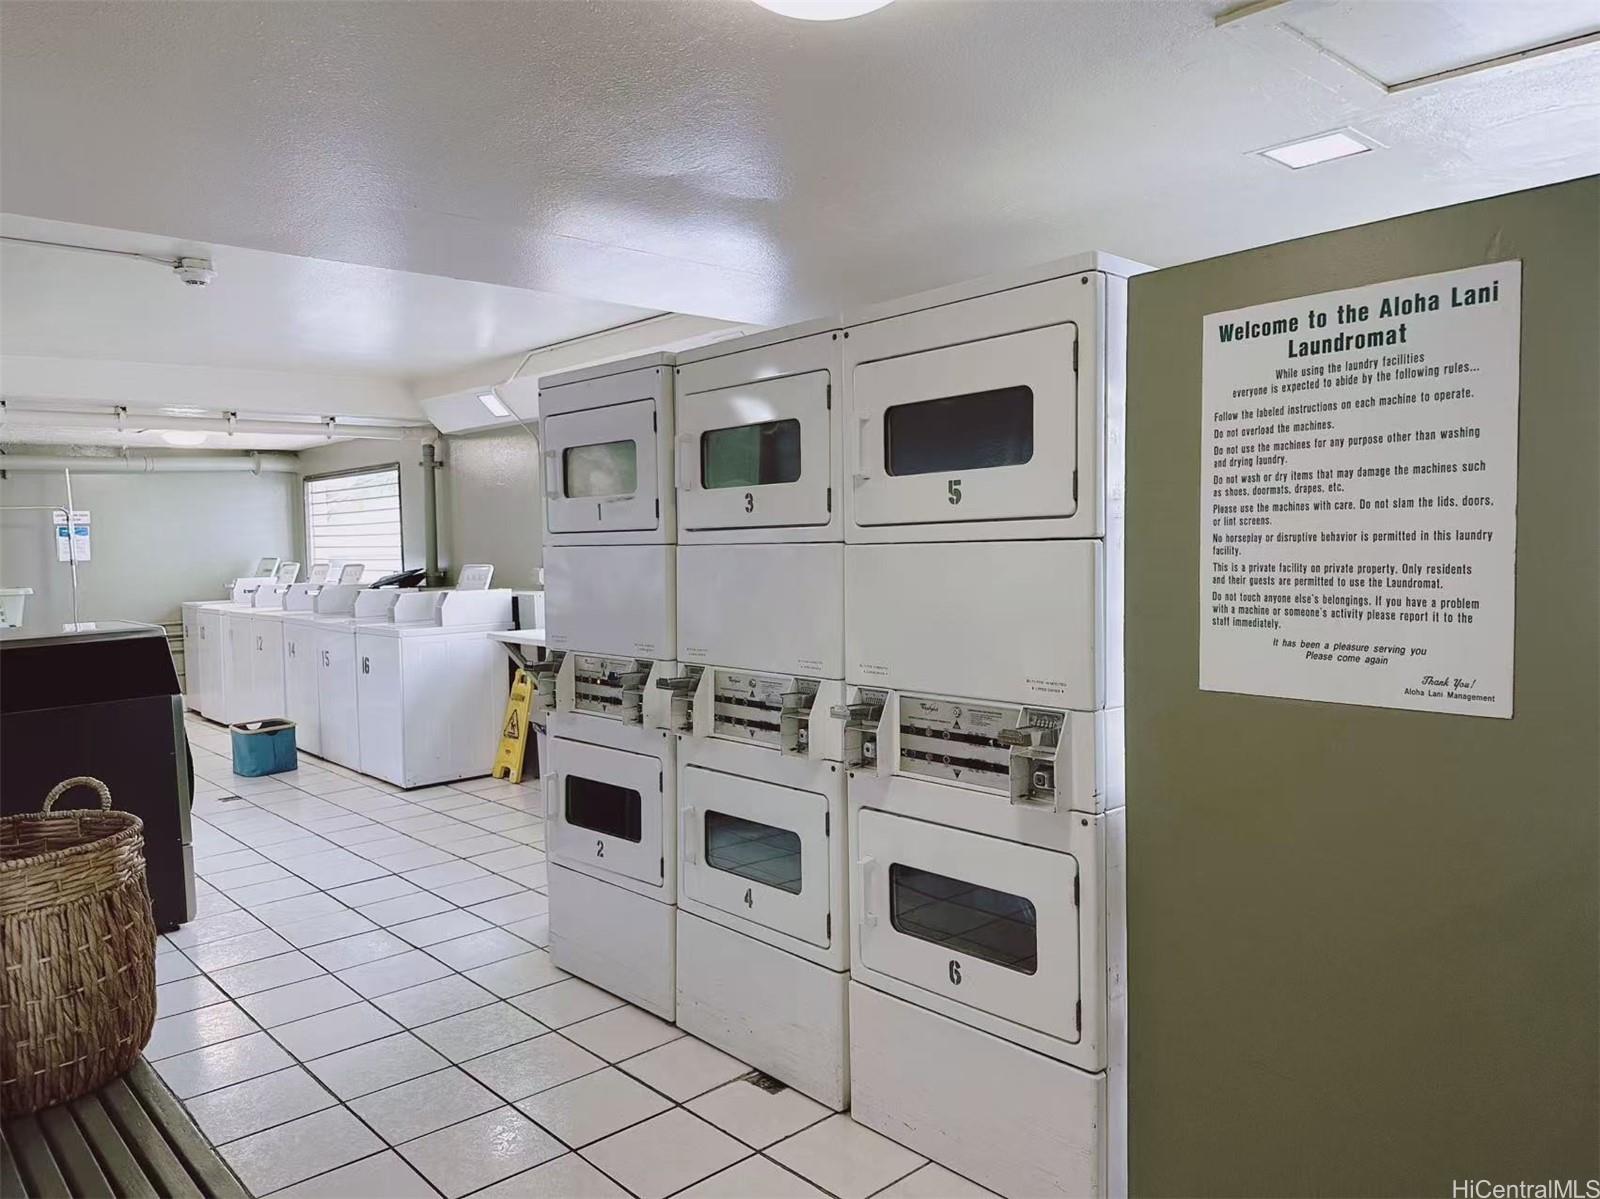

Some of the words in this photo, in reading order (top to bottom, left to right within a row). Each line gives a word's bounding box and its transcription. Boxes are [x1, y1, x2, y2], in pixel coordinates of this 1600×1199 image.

[1219, 314, 1298, 343] Welcome
[1308, 307, 1326, 329] to
[1336, 300, 1368, 325] the
[1379, 289, 1439, 319] Aloha
[1451, 279, 1498, 308] Lani
[1288, 322, 1406, 359] Laundromat
[1275, 367, 1298, 380] While
[1301, 363, 1325, 378] using
[1328, 361, 1342, 373] the
[1345, 356, 1379, 373] laundry
[1382, 350, 1425, 367] facilities
[1232, 386, 1268, 399] everyone
[1271, 383, 1279, 393] is
[1281, 378, 1320, 394] expected
[1323, 377, 1332, 388] to
[1335, 373, 1359, 386] abide
[1362, 371, 1373, 385] by
[1376, 369, 1392, 382] the
[1395, 363, 1439, 381] following
[1443, 359, 1480, 374] rules...
[1214, 410, 1239, 422] Follow
[1241, 408, 1254, 419] the
[1256, 405, 1285, 418] labeled
[1287, 400, 1338, 415] instructions
[1341, 400, 1352, 409] on
[1355, 396, 1376, 408] each
[1379, 391, 1417, 406] machine
[1420, 391, 1430, 402] to
[1434, 386, 1474, 401] operate.
[1213, 428, 1224, 438] Do
[1226, 427, 1239, 437] not
[1241, 424, 1275, 436] overload
[1277, 422, 1290, 433] the
[1293, 418, 1335, 432] machines.
[1213, 445, 1224, 455] Do
[1226, 445, 1239, 454] not
[1241, 444, 1255, 453] use
[1258, 441, 1271, 452] the
[1273, 438, 1311, 451] machines
[1314, 437, 1327, 448] for
[1329, 438, 1345, 448] any
[1348, 434, 1384, 447] purpose
[1387, 430, 1412, 443] other
[1415, 428, 1436, 441] than
[1440, 425, 1480, 440] washing
[1214, 457, 1227, 468] and
[1229, 455, 1254, 468] drying
[1256, 453, 1288, 467] laundry.
[1213, 474, 1223, 484] Do
[1225, 474, 1238, 484] not
[1241, 472, 1261, 483] wash
[1263, 474, 1273, 482] or
[1275, 471, 1288, 483] dry
[1291, 469, 1314, 480] items
[1317, 468, 1333, 479] that
[1336, 469, 1354, 479] may
[1357, 465, 1391, 478] damage
[1394, 464, 1409, 475] the
[1412, 461, 1458, 474] machines
[1462, 459, 1486, 472] such
[948, 479, 962, 505] 5
[1213, 489, 1222, 497] as
[1328, 481, 1345, 492] etc.
[744, 493, 754, 513] 3
[1212, 503, 1237, 514] Please
[1240, 504, 1254, 513] use
[1257, 502, 1270, 512] the
[1272, 500, 1310, 512] machines
[1313, 500, 1332, 510] with
[1334, 501, 1356, 510] care.
[1359, 498, 1371, 509] Do
[1374, 498, 1389, 509] not
[1392, 497, 1415, 508] slam
[1418, 496, 1434, 507] the
[1212, 518, 1221, 526] or
[1223, 516, 1236, 526] lint
[1239, 517, 1272, 526] screens.
[1212, 533, 1223, 542] No
[1225, 532, 1263, 544] horseplay
[1265, 534, 1274, 542] or
[1276, 531, 1318, 543] disruptive
[1320, 531, 1358, 542] behavior
[1360, 530, 1369, 541] is
[1372, 530, 1417, 542] permitted
[1420, 530, 1429, 540] in
[1433, 529, 1452, 541] this
[1455, 529, 1493, 542] laundry
[1212, 545, 1242, 555] facility.
[1212, 562, 1229, 571] This
[1231, 562, 1239, 572] is
[1241, 564, 1246, 572] a
[1248, 562, 1276, 574] private
[1279, 562, 1308, 574] facility
[1323, 563, 1354, 574] private
[1357, 563, 1399, 575] property.
[1402, 563, 1423, 575] Only
[1426, 563, 1472, 575] residents
[1212, 574, 1226, 584] and
[1228, 575, 1247, 584] their
[1249, 575, 1275, 586] guests
[1278, 577, 1291, 585] are
[1294, 575, 1334, 587] permitted
[1337, 577, 1346, 586] to
[1349, 578, 1365, 587] use
[1368, 576, 1383, 587] the
[1386, 576, 1444, 588] Laundromat.
[1212, 591, 1222, 600] Do
[1225, 592, 1237, 601] not
[1239, 592, 1261, 602] touch
[1263, 594, 1291, 604] anyone
[1294, 593, 1321, 604] else's
[1322, 594, 1372, 607] belongings.
[1375, 595, 1382, 606] If
[1385, 598, 1402, 608] you
[1405, 596, 1428, 607] have
[1431, 599, 1437, 607] a
[1440, 597, 1480, 610] problem
[1212, 603, 1229, 613] with
[1238, 604, 1270, 615] machine
[1272, 607, 1283, 616] or
[1284, 606, 1328, 617] someone's
[1331, 607, 1364, 620] activity
[1366, 608, 1396, 621] please
[1399, 610, 1429, 623] report
[1432, 611, 1440, 622] it
[1443, 612, 1454, 622] to
[1457, 612, 1473, 623] the
[1212, 615, 1230, 626] staff
[1232, 616, 1282, 629] immediately.
[288, 642, 295, 657] 14
[1272, 638, 1279, 646] It
[1281, 638, 1298, 647] has
[1299, 639, 1321, 649] been
[1332, 641, 1371, 653] pleasure
[1372, 643, 1407, 656] serving
[1409, 647, 1428, 657] you
[321, 650, 330, 667] 15
[361, 656, 370, 674] 16
[1305, 650, 1334, 661] Please
[1336, 654, 1362, 663] come
[1364, 654, 1390, 665] again
[1420, 675, 1451, 686] Thank
[1452, 678, 1477, 689] You!
[1404, 687, 1425, 696] Aloha
[1428, 689, 1444, 697] Lani
[1447, 691, 1495, 702] Management
[596, 840, 604, 858] 2
[744, 888, 754, 909] 4
[949, 959, 962, 986] 6
